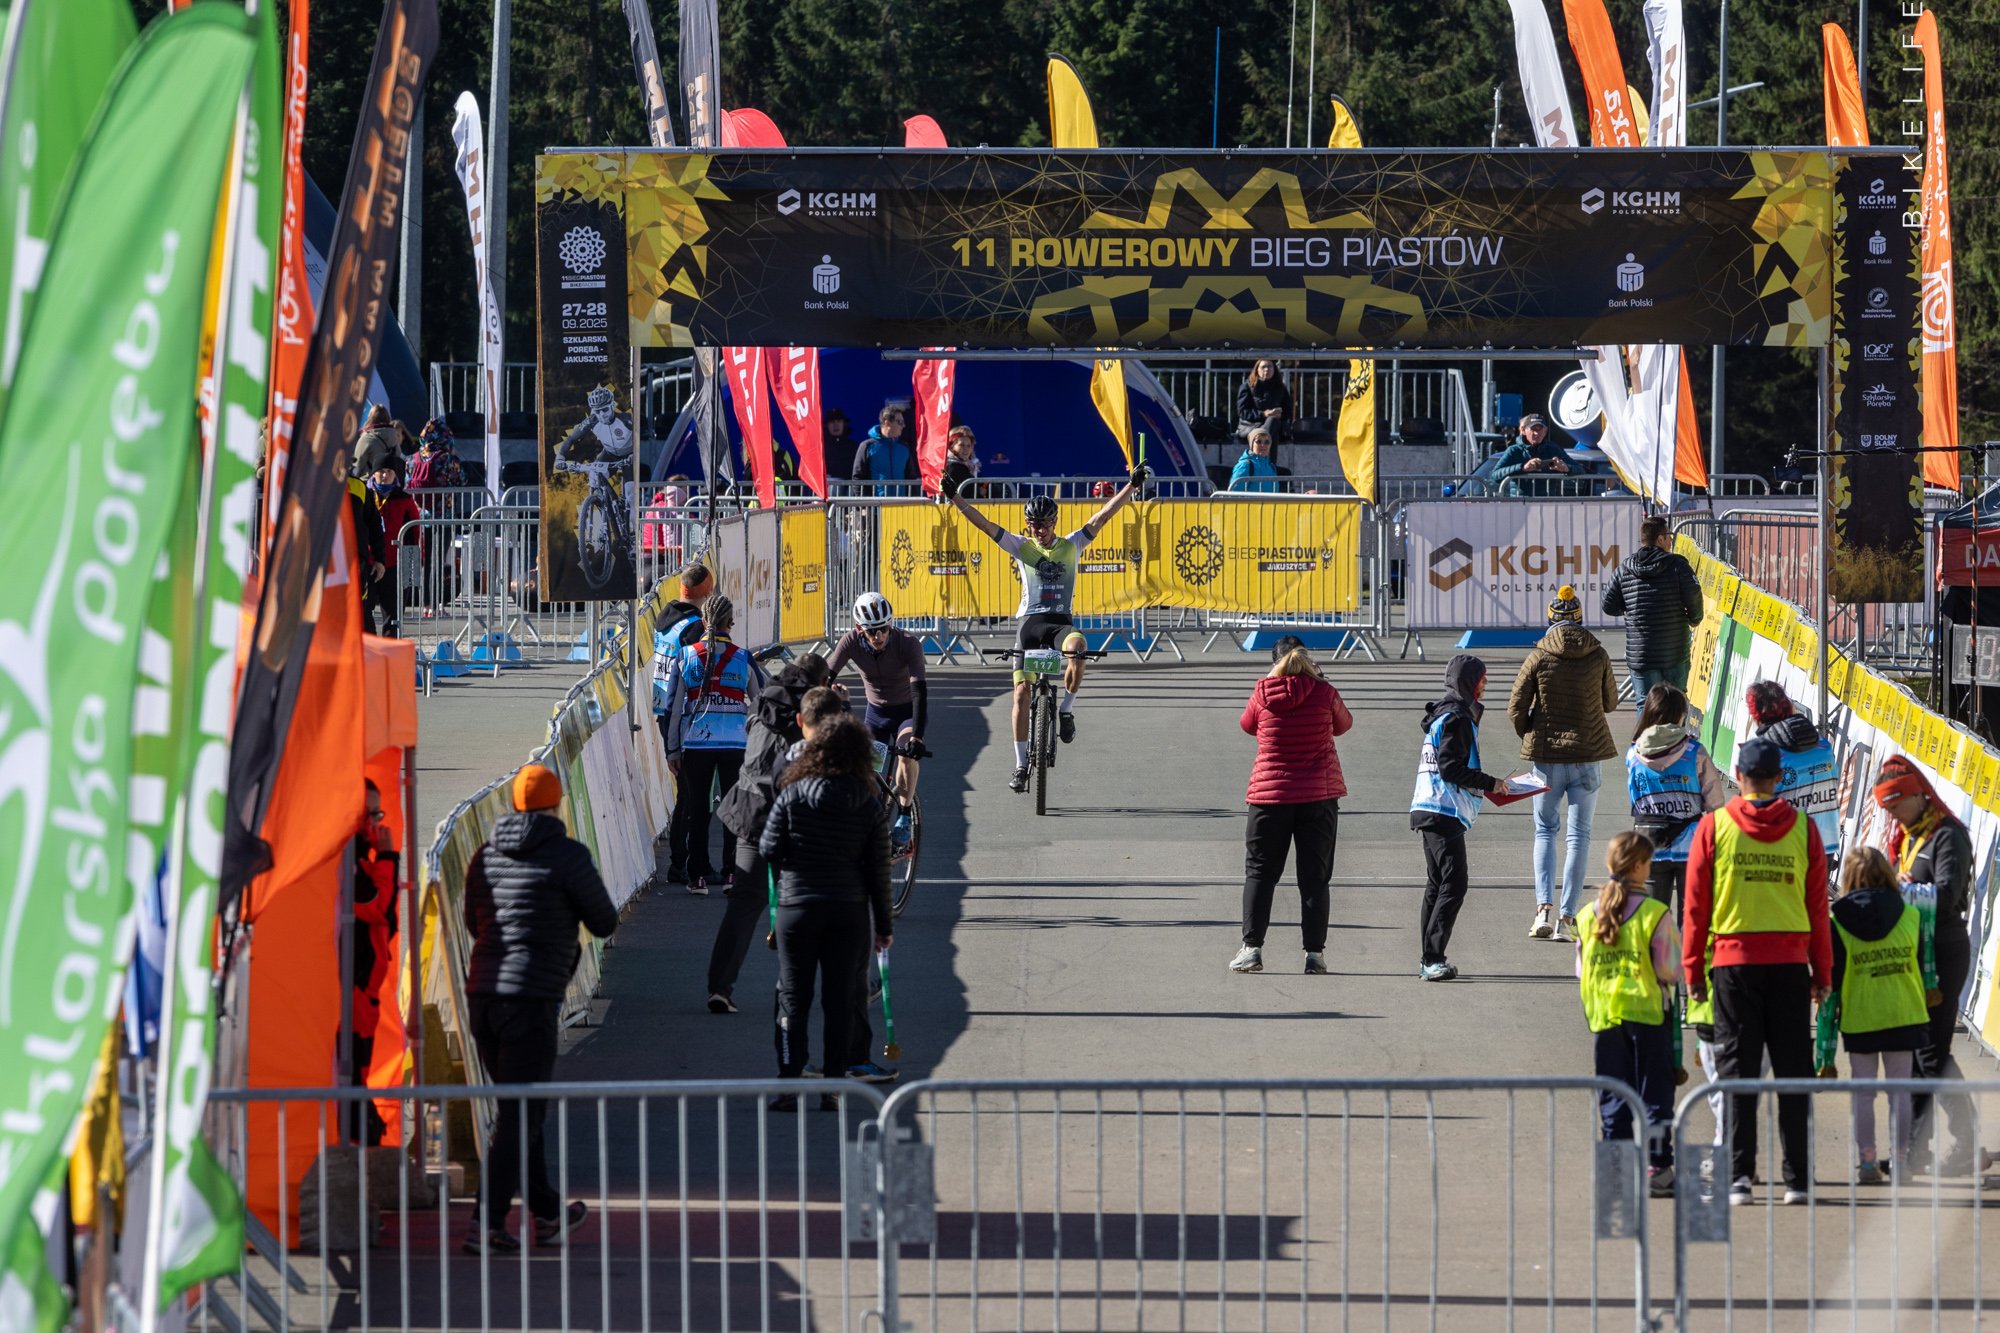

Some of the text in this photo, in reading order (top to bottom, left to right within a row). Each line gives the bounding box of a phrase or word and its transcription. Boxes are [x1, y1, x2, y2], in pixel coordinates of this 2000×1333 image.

[808, 192, 877, 208] KGHM
[1612, 191, 1681, 207] KGHM
[1858, 195, 1897, 205] KGHM
[951, 229, 1504, 267] 11 ROWEROWY BIEG PIASTÓW
[804, 301, 849, 310] Bank Polski
[1608, 298, 1653, 308] Bank Polski
[562, 303, 607, 317] 27-28
[562, 319, 608, 329] 09.2025
[562, 336, 608, 344] SZKLARSKA
[567, 346, 600, 354] PORĘBA
[1862, 394, 1896, 402] Szklarska
[1490, 545, 1620, 576] KGHM
[1266, 562, 1308, 571] JAKUSZYCE
[1490, 584, 1557, 593] POLSKA
